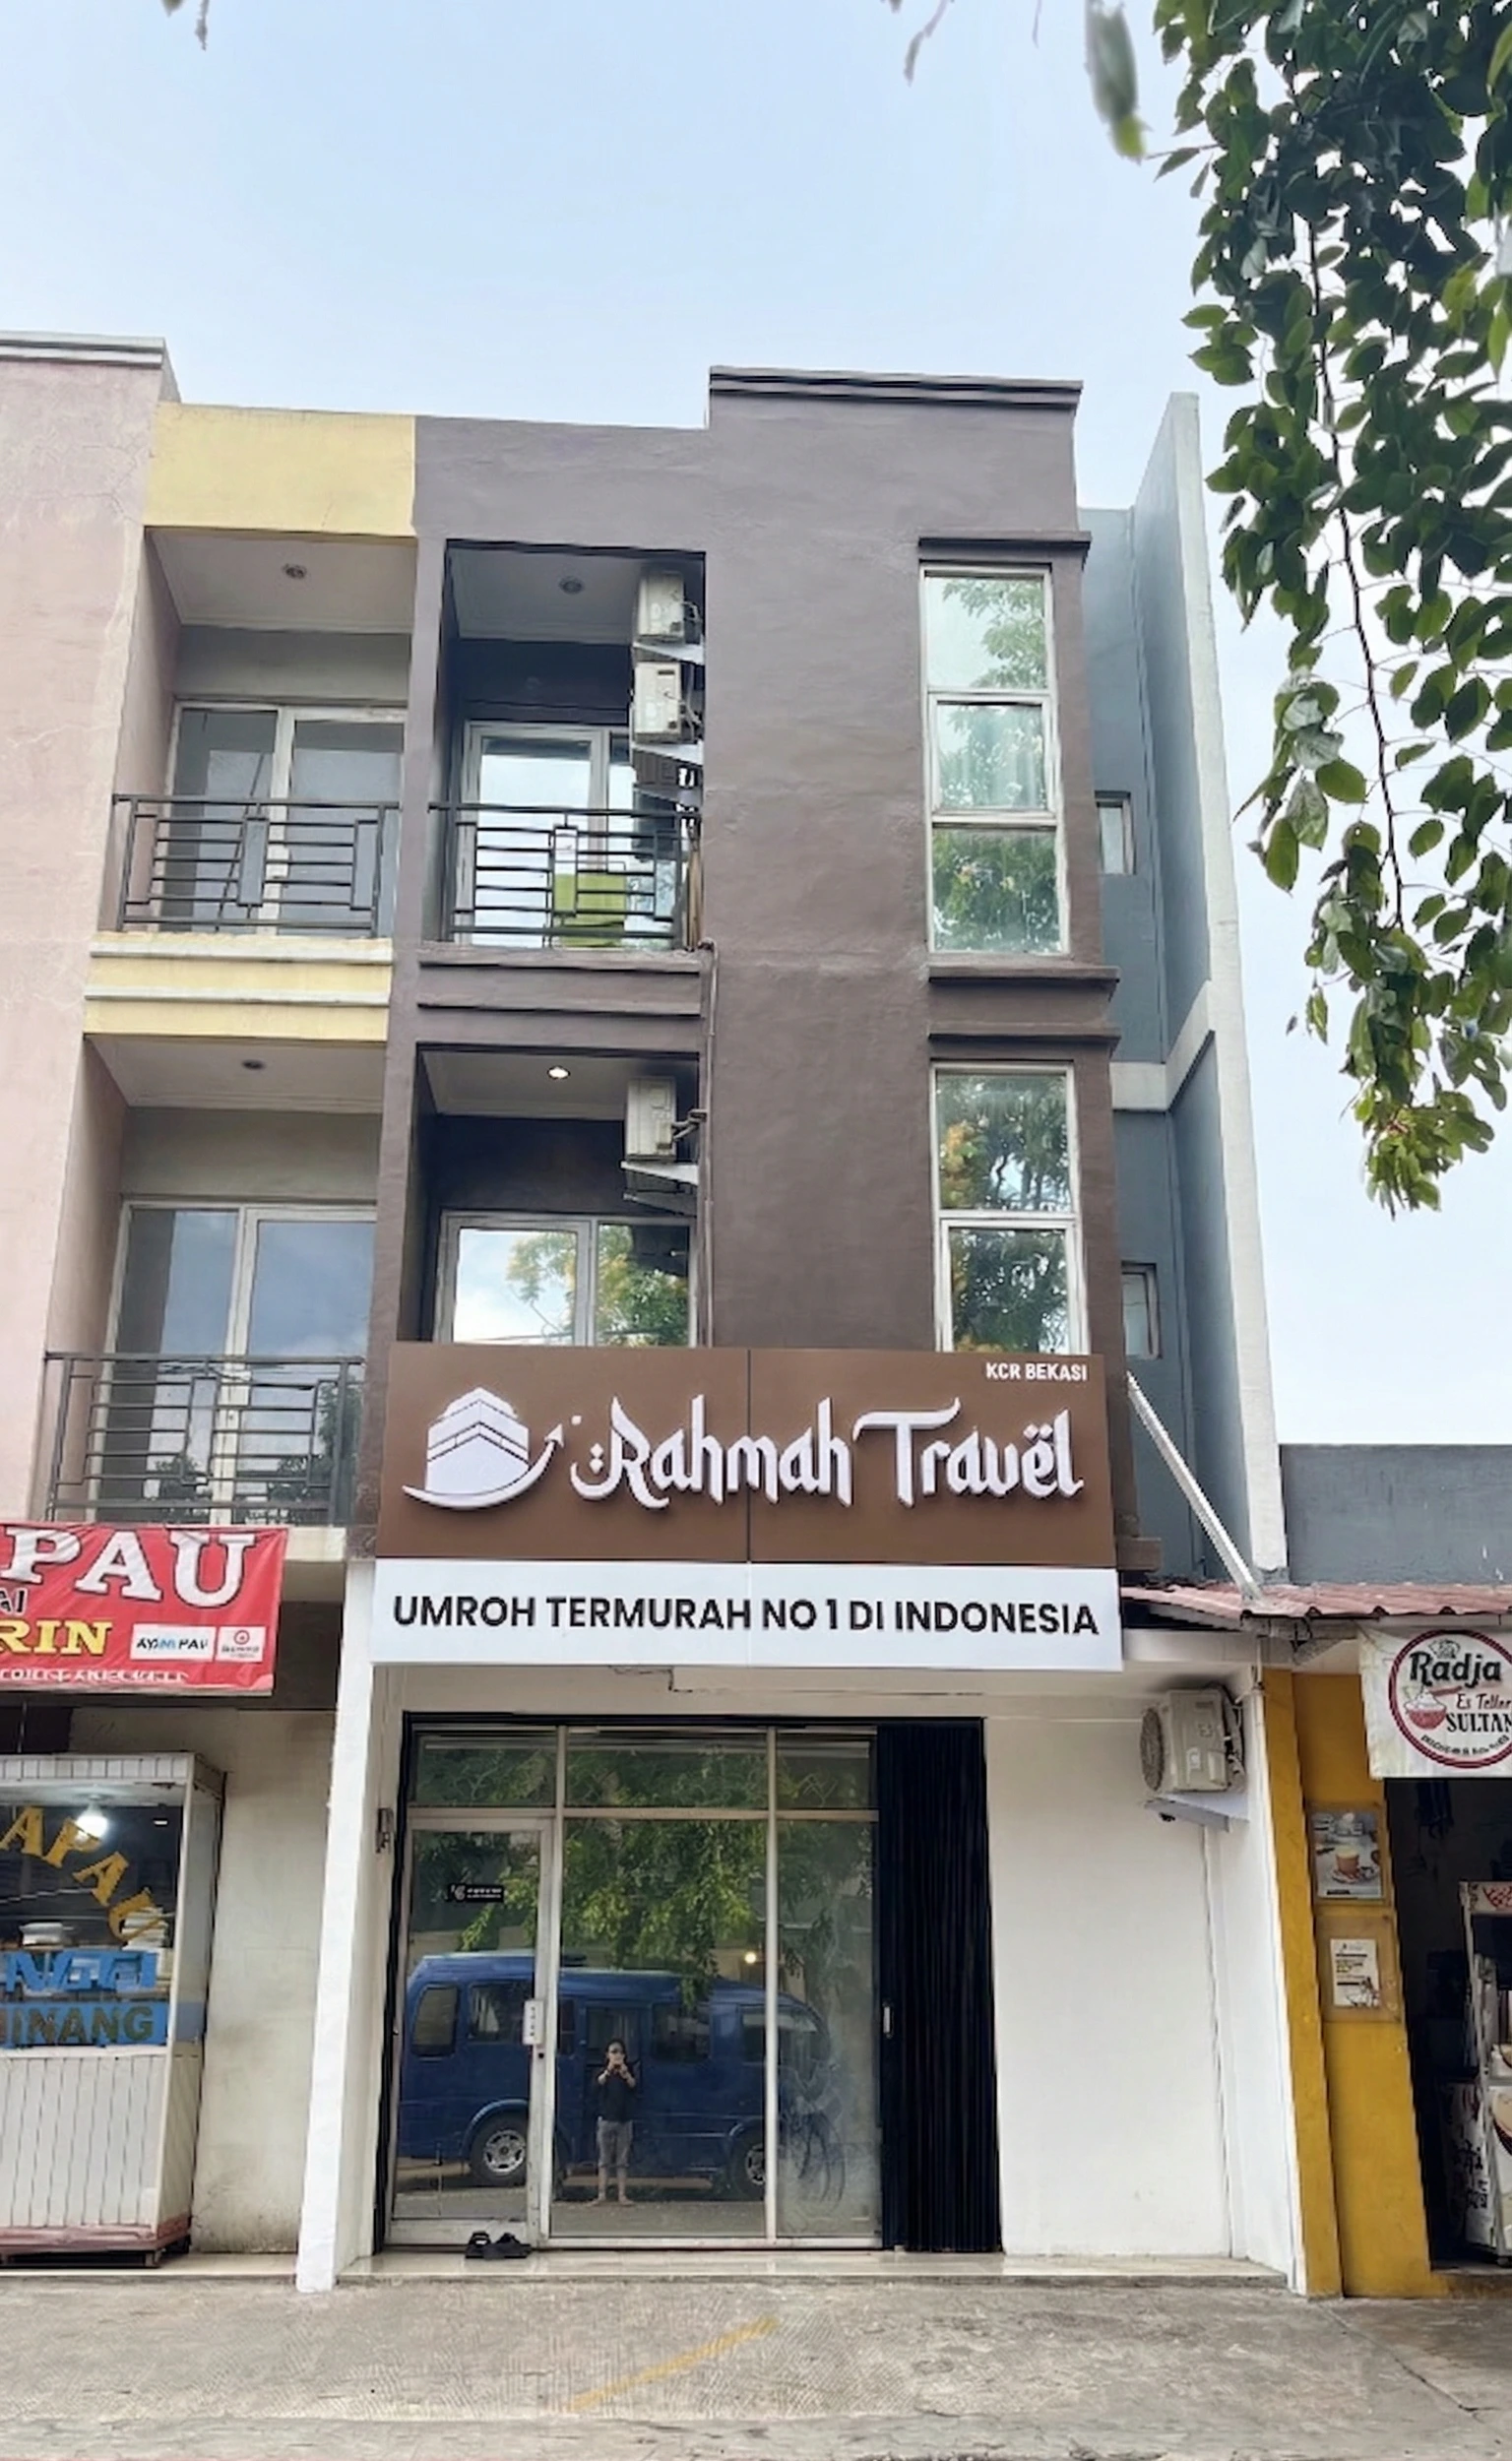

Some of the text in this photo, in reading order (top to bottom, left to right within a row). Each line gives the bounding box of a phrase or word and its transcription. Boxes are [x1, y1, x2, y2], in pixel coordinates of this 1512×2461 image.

[985, 1361, 1088, 1381] KCR BEKASI
[570, 1394, 852, 1509] Rahmah
[394, 1596, 1101, 1635] UMROH TERMURAH NO 1 DI INDONESIA
[1409, 1650, 1502, 1688] Radja
[1457, 1692, 1472, 1710] Es
